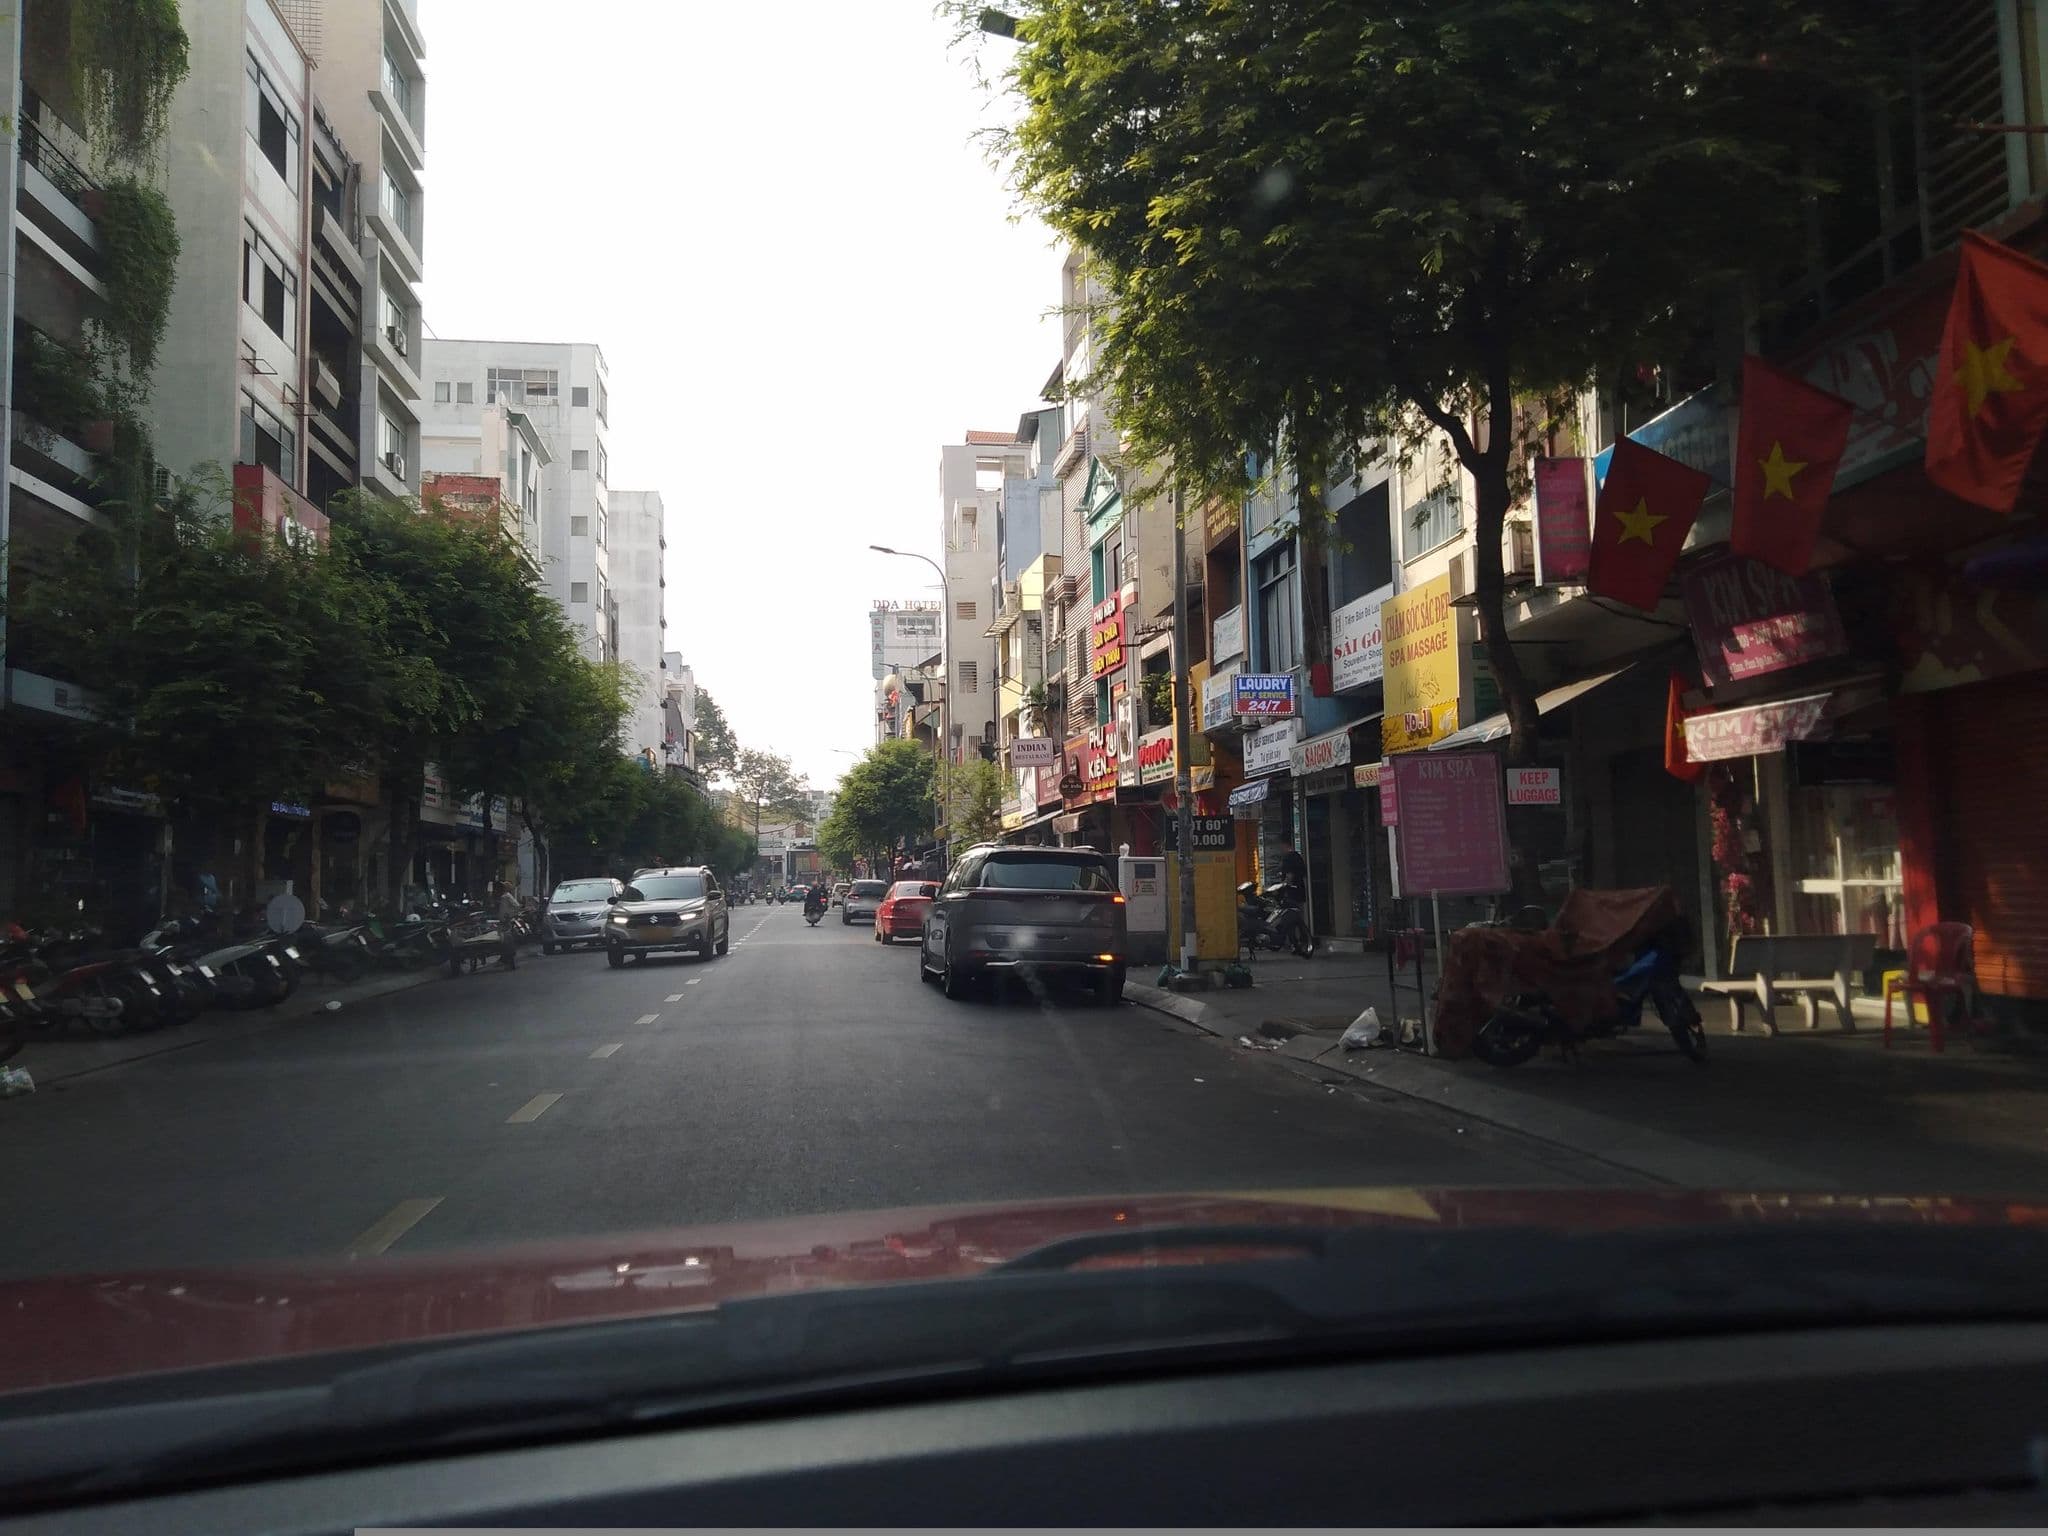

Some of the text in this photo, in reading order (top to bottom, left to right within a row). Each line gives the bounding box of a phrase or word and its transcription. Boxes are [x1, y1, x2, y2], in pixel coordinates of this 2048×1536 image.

[873, 599, 900, 610] DDA
[1406, 600, 1420, 635] SÓC
[1334, 636, 1358, 661] SÀI
[1390, 631, 1448, 668] SPA MASSAGE
[1238, 678, 1288, 691] LAUDRY
[1259, 691, 1287, 699] SERVICE
[1248, 700, 1281, 711] 24/7
[1687, 717, 1742, 740] KIM
[1017, 743, 1047, 753] INDIAN
[1305, 740, 1334, 768] SAIGON
[1418, 759, 1476, 779] KIM SPA
[1519, 772, 1549, 785] KEEP
[1510, 788, 1558, 802] LUGGAGE
